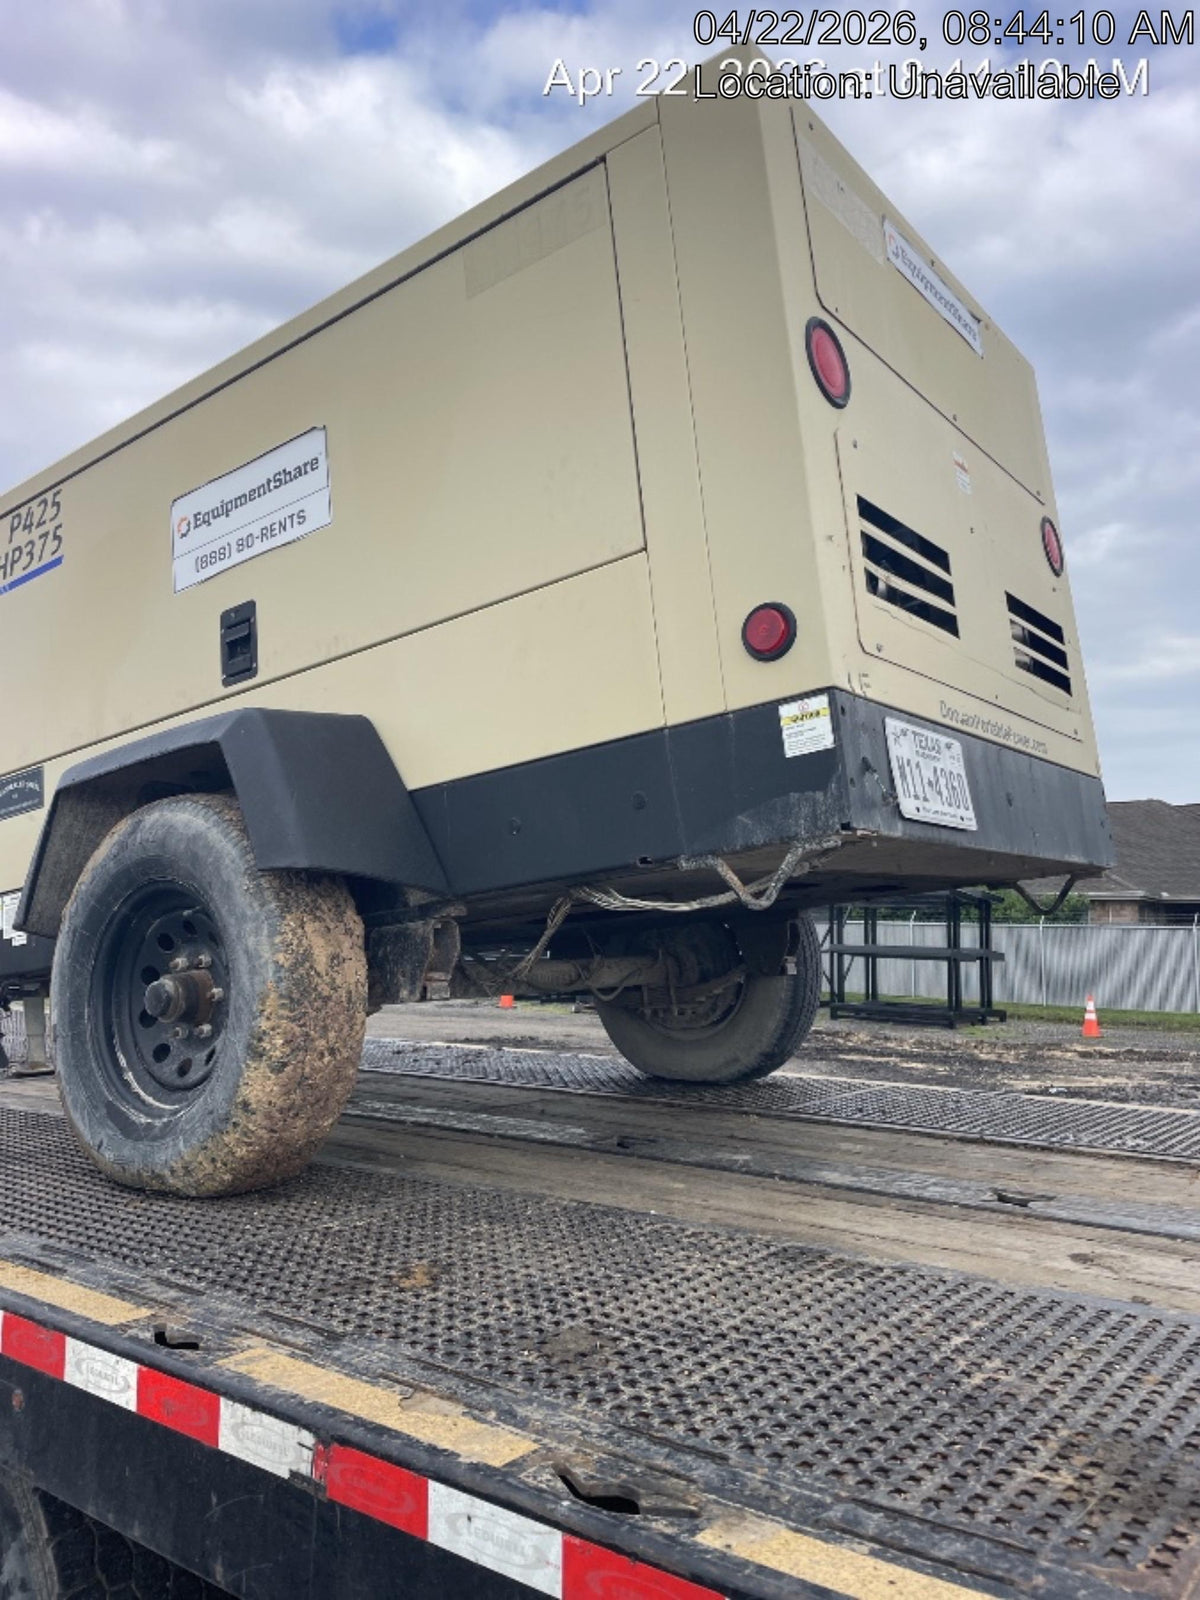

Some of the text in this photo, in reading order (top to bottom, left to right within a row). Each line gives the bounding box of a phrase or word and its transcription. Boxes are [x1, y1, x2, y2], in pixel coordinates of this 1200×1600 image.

[8, 488, 62, 544] P425
[192, 454, 320, 530] EquipmentShare
[195, 509, 307, 573] (888) 80-RENTS
